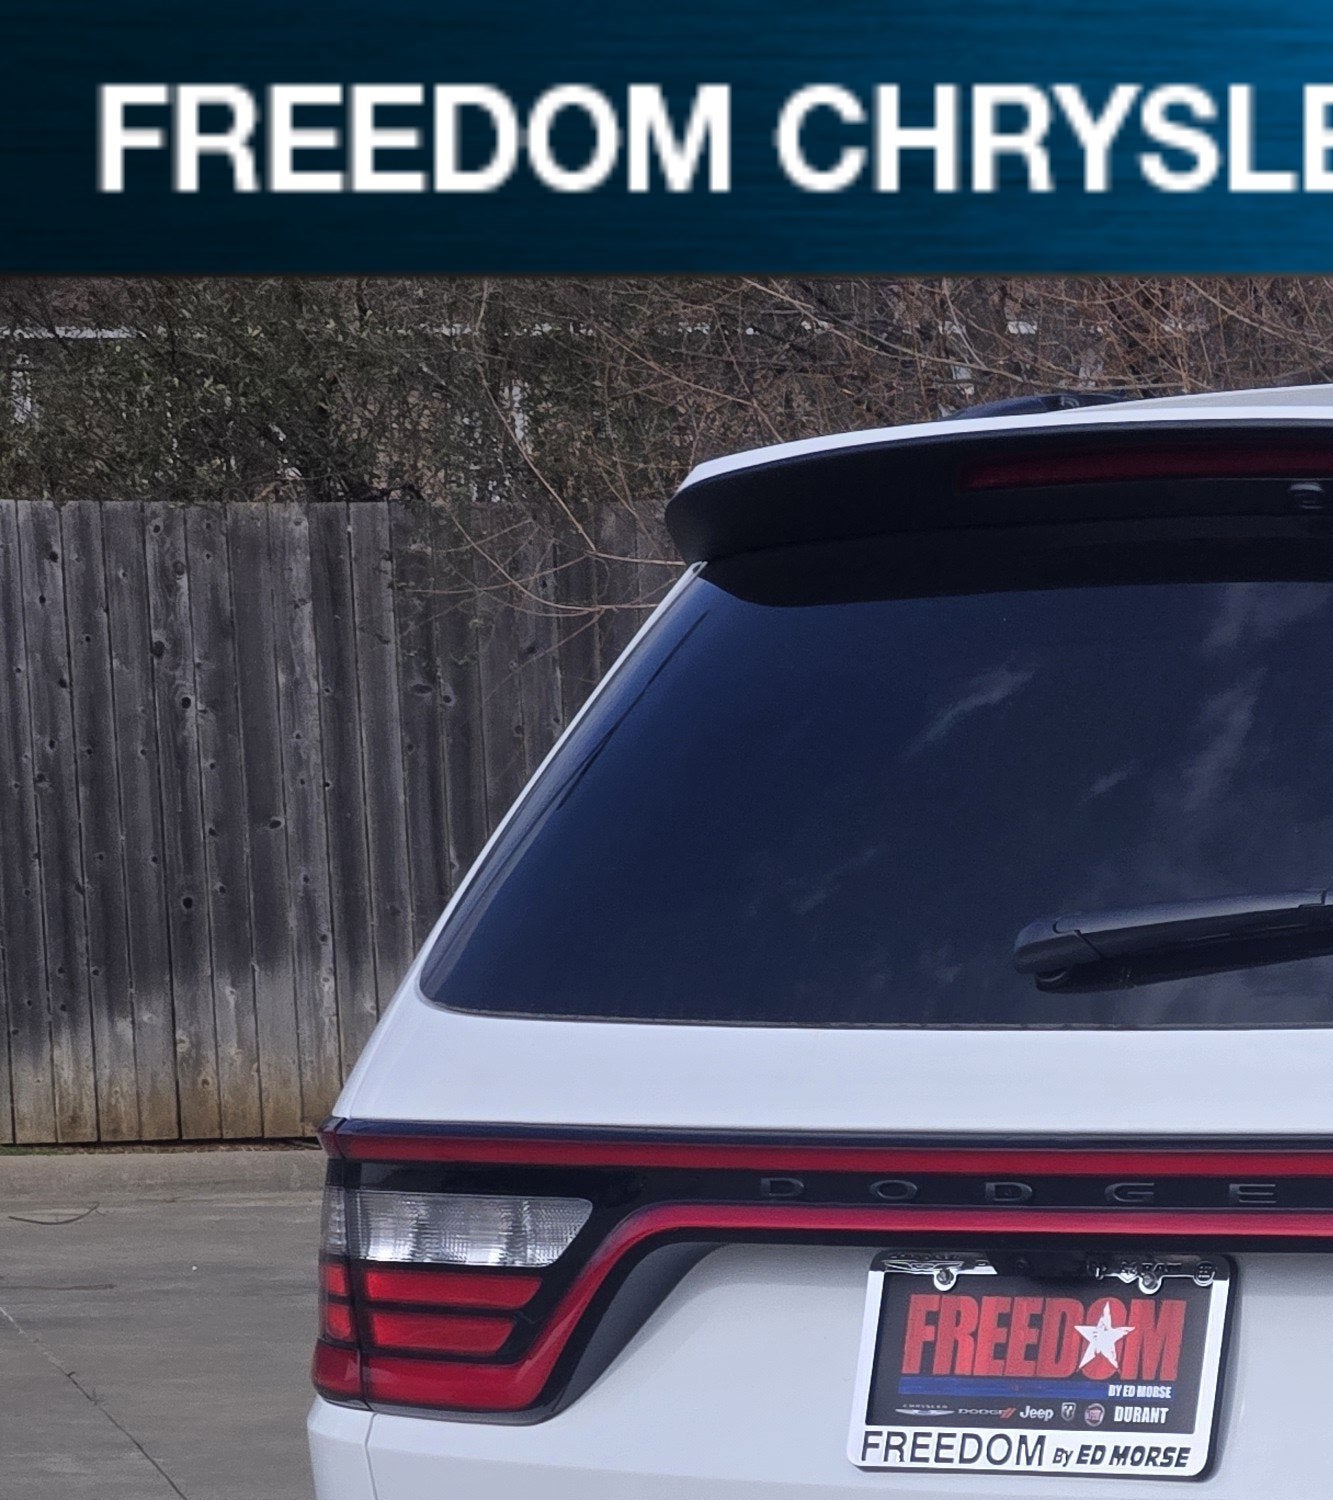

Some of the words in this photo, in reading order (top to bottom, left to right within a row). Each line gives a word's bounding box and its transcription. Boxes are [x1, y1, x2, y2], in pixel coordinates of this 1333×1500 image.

[760, 1176, 1277, 1204] DODGE
[902, 1294, 1187, 1381] FREEDOM
[1108, 1384, 1122, 1398] BY
[1122, 1385, 1136, 1398] ED
[1136, 1385, 1172, 1399] MORSE
[1019, 1405, 1054, 1422] Jeep
[1114, 1406, 1169, 1424] DURANT
[861, 1430, 1047, 1467] FREEDOM
[1076, 1444, 1105, 1466] ED
[1108, 1445, 1192, 1468] MORSE
